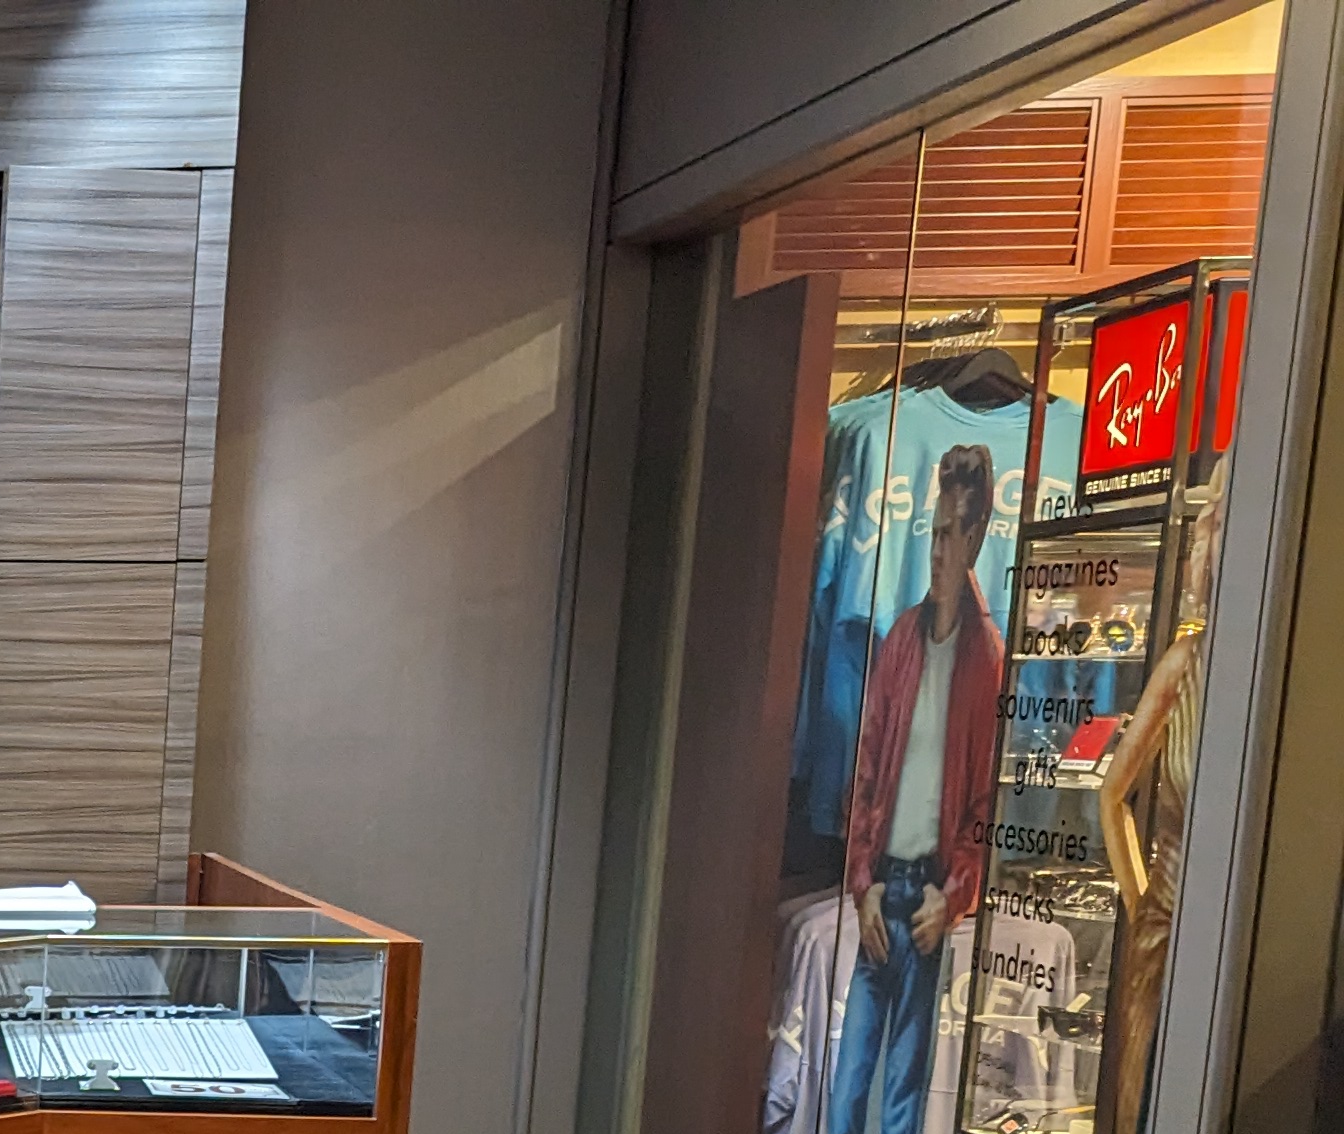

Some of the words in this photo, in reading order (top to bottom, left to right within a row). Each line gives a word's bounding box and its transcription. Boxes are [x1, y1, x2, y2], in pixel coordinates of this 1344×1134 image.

[1085, 474, 1129, 496] GENUINE
[1130, 469, 1161, 489] SINCE
[1041, 495, 1094, 522] news
[1003, 548, 1119, 600] magazines
[1022, 615, 1085, 656] books
[996, 685, 1094, 726] souvenirs
[1014, 746, 1057, 796] gifts
[972, 819, 1089, 862] accessories
[987, 886, 1054, 924] snacks
[972, 943, 1057, 993] sundries
[170, 1083, 246, 1095] 50
